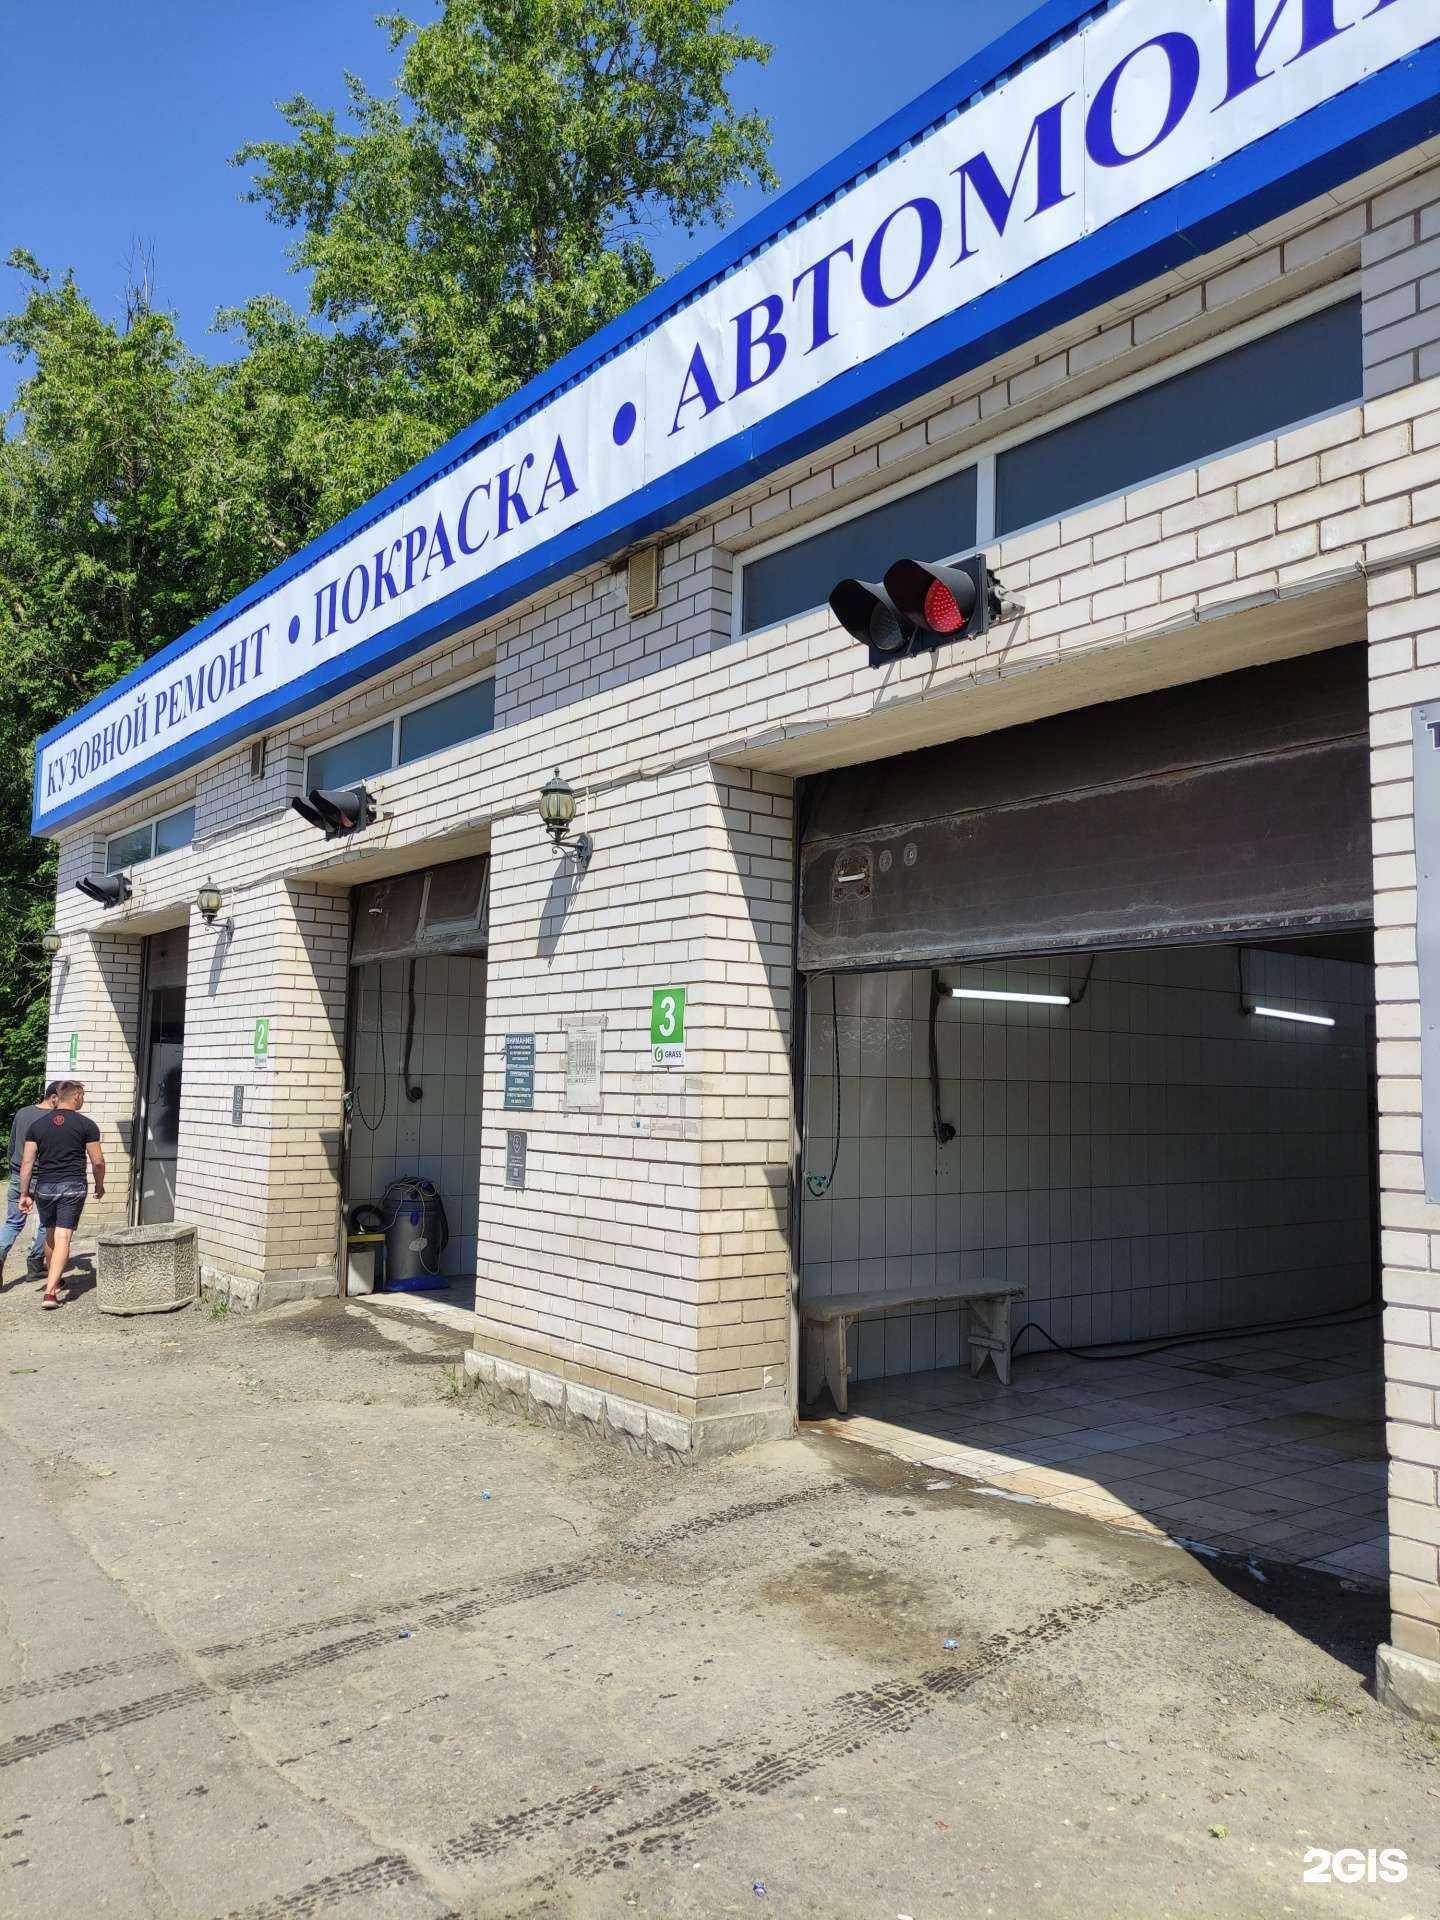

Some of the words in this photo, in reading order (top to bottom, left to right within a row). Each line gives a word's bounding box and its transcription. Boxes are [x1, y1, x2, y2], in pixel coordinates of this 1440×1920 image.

[47, 692, 149, 798] КУЗОВНОЙ
[153, 623, 271, 737] РЕМОНТ
[312, 433, 580, 646] ПОКРАСКА
[667, 0, 1397, 437] АВТОМО
[659, 996, 676, 1037] 3
[257, 1023, 265, 1050] 2
[664, 1050, 682, 1058] GRASS
